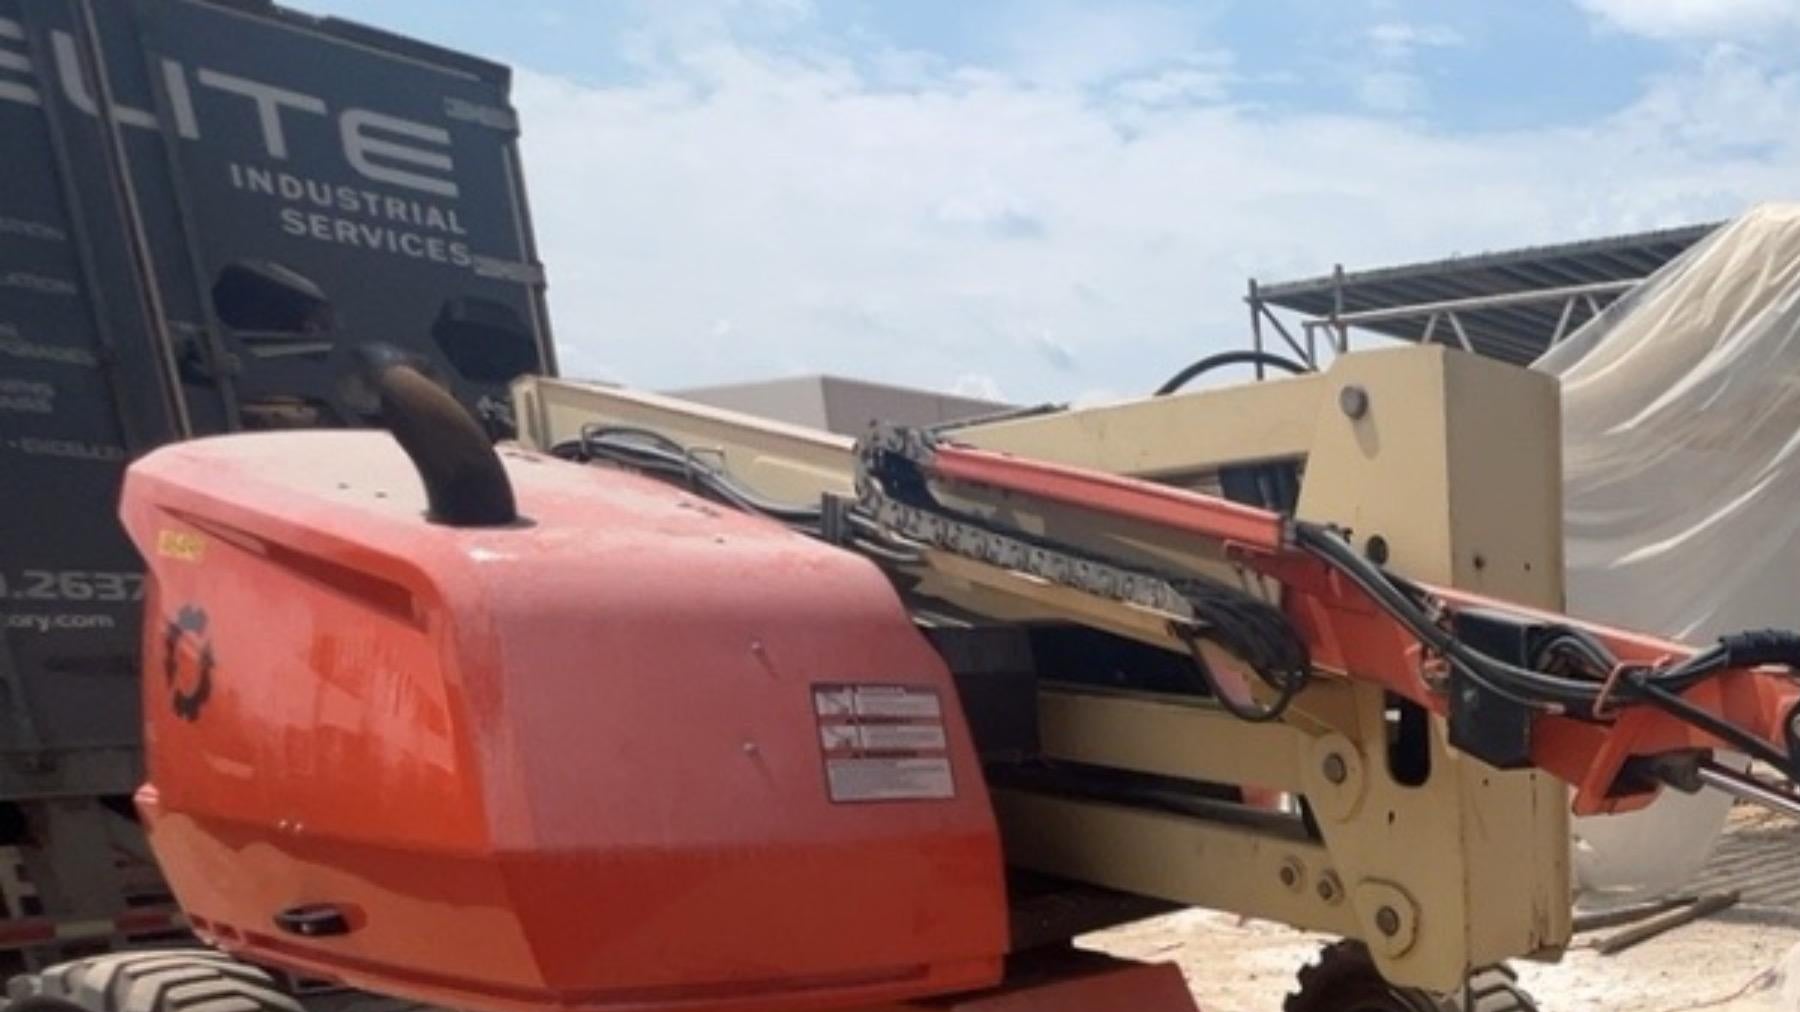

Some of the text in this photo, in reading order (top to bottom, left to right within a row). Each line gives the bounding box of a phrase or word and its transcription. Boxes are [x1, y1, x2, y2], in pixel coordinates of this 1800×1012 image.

[229, 162, 468, 235] INDUSTRIAL
[280, 208, 472, 267] SERVICES
[0, 568, 144, 601] .2637
